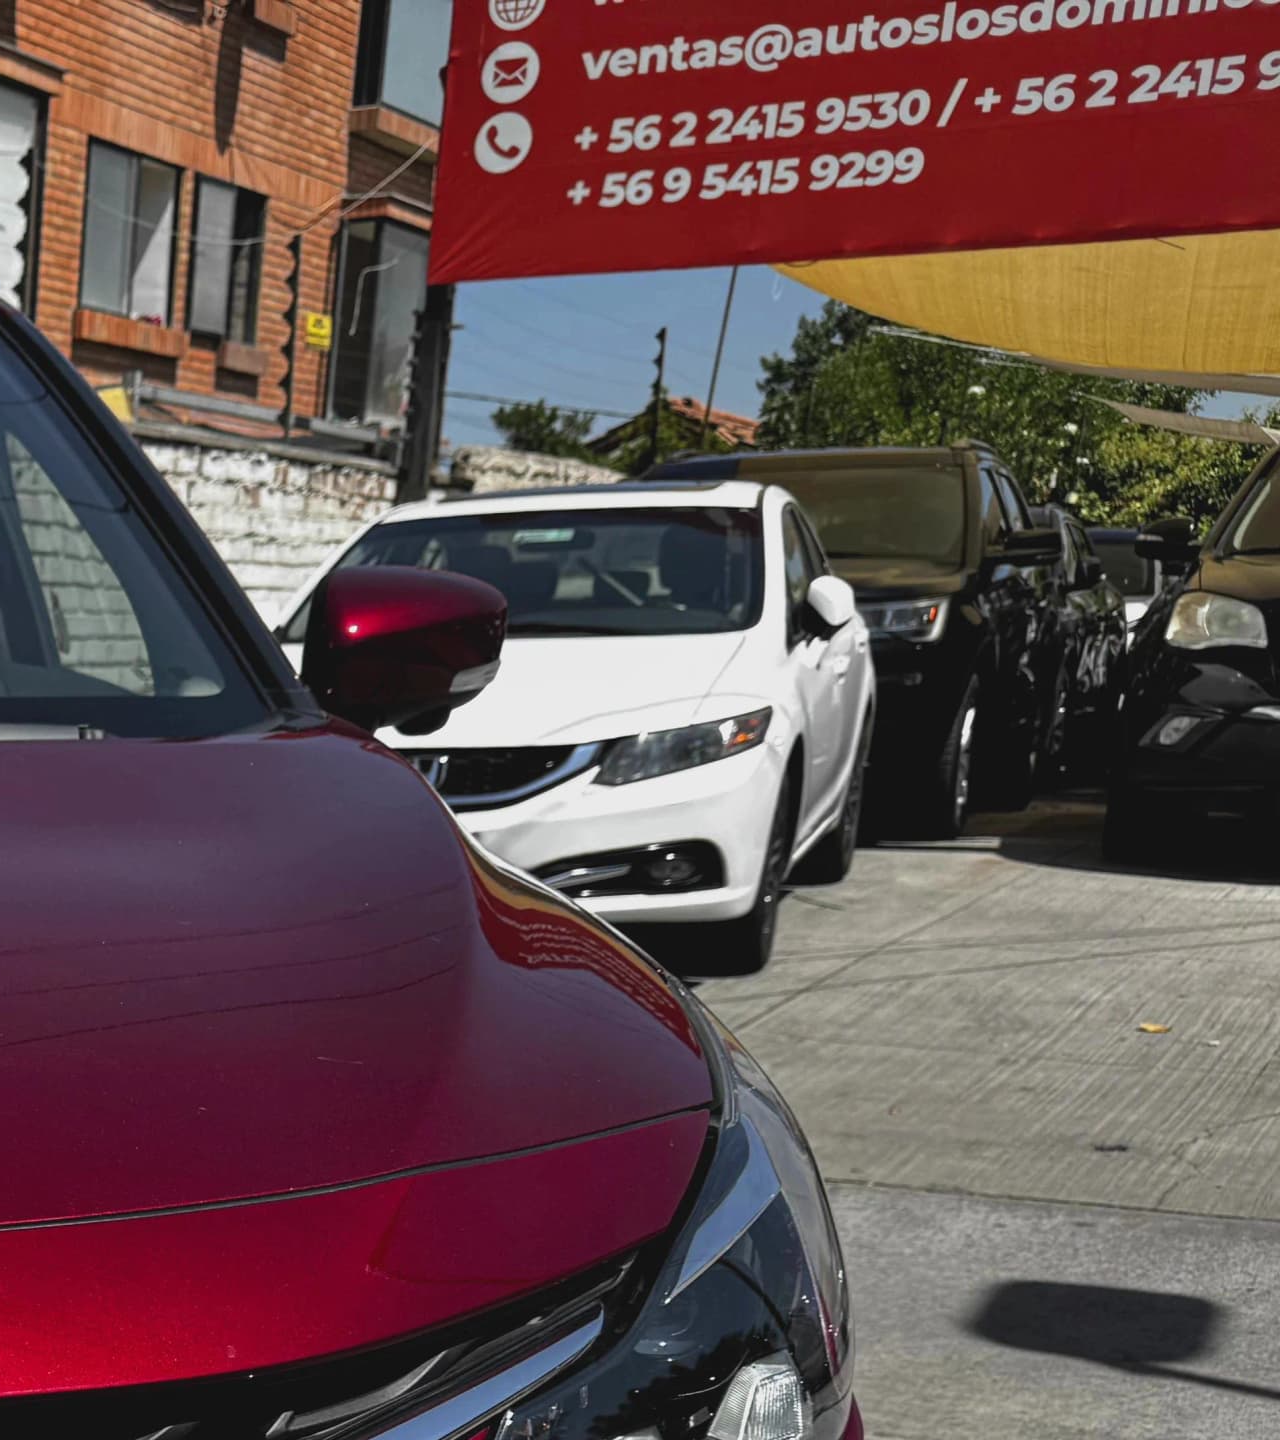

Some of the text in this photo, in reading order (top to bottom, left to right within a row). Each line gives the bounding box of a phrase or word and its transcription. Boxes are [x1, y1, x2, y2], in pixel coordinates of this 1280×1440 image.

[582, 0, 1280, 79] ventas@autoslosdom
[574, 126, 598, 150] +
[606, 115, 662, 152] 56
[669, 112, 698, 147] 2
[705, 101, 806, 144] 2415
[815, 89, 931, 134] 9530
[937, 78, 968, 127] /
[974, 88, 1001, 112] +
[1011, 74, 1076, 115] 56
[1085, 70, 1119, 108] 2
[1128, 55, 1246, 103] 2415
[567, 147, 925, 207] + 56 9 5415 9299
